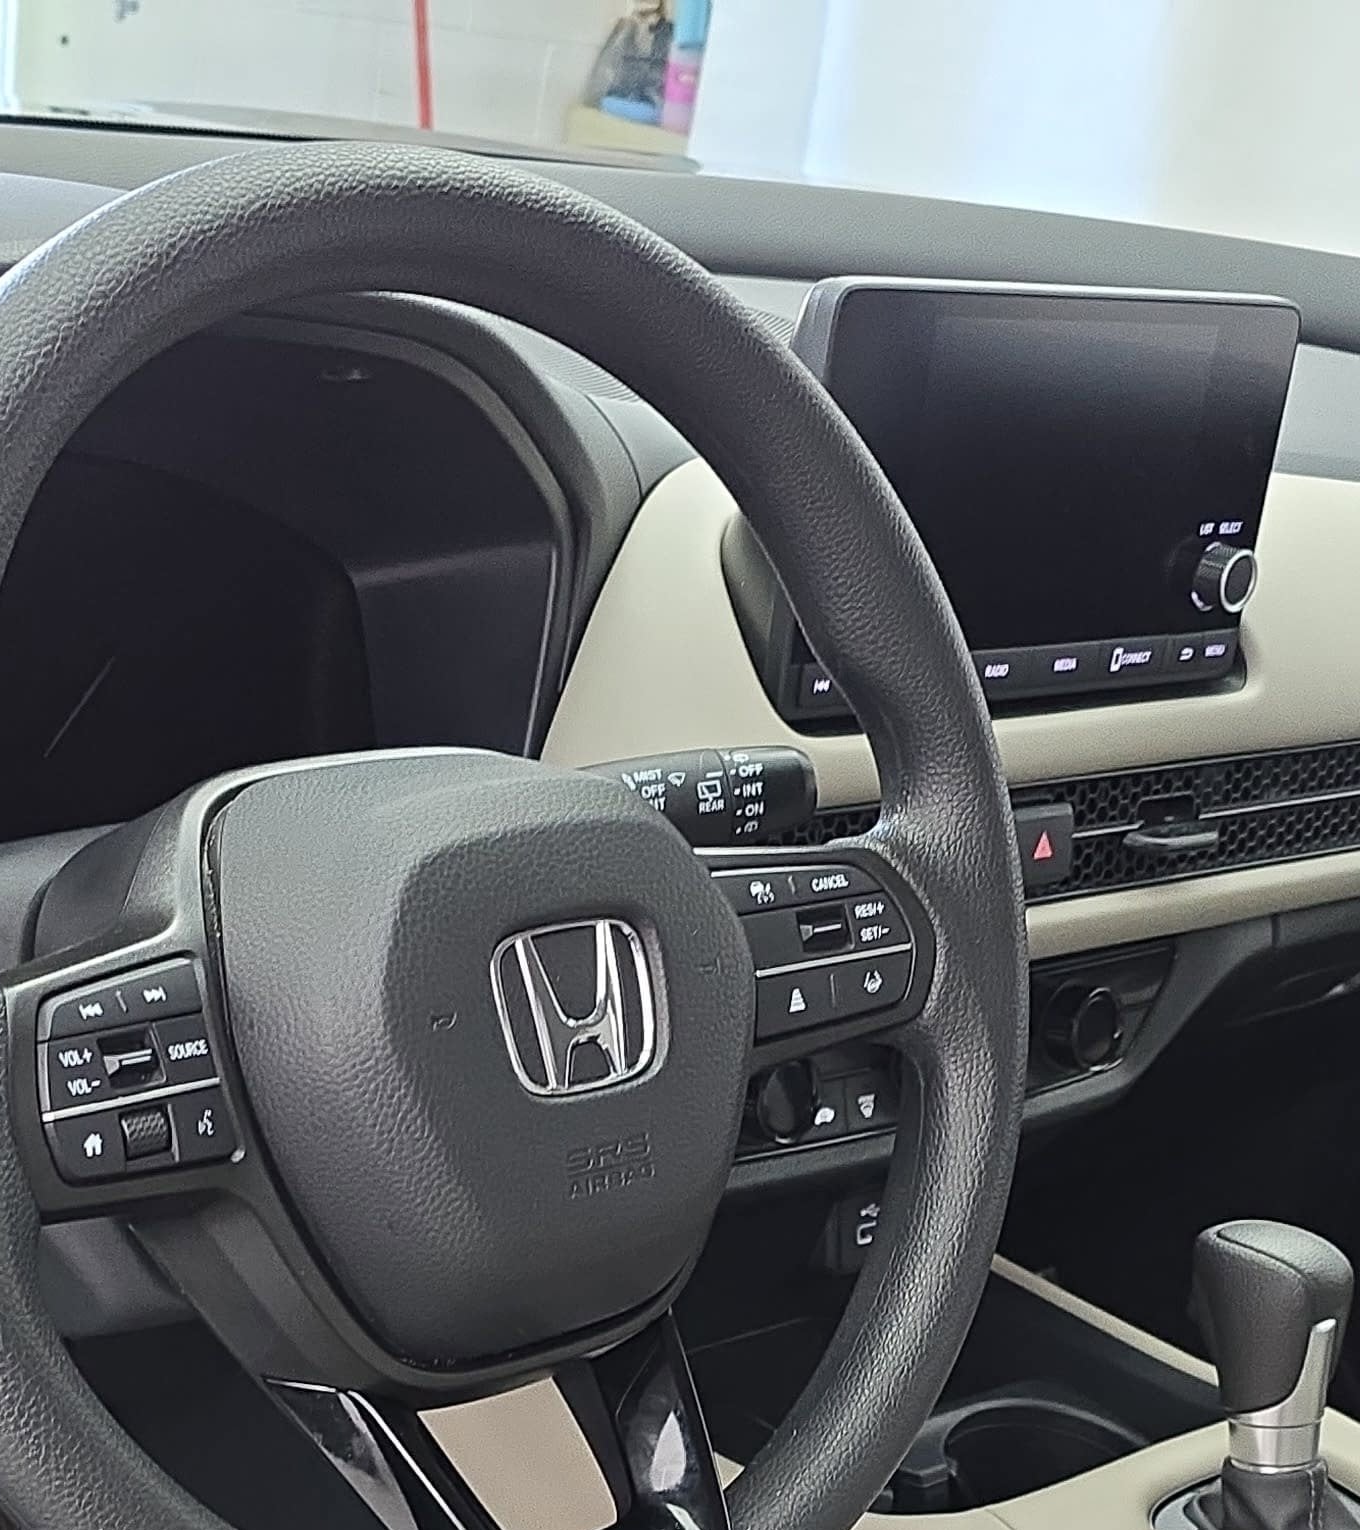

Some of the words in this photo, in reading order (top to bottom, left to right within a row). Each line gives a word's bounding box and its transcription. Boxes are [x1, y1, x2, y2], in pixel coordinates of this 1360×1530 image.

[984, 663, 1009, 678] RADIO
[1053, 657, 1077, 672] MEDIA
[738, 763, 763, 778] OFF
[641, 783, 666, 799] OFF
[742, 782, 764, 798] INT
[699, 799, 725, 814] REAR
[744, 801, 764, 817] ON
[811, 873, 849, 893] CANCEL
[168, 1039, 209, 1061] SOURCE
